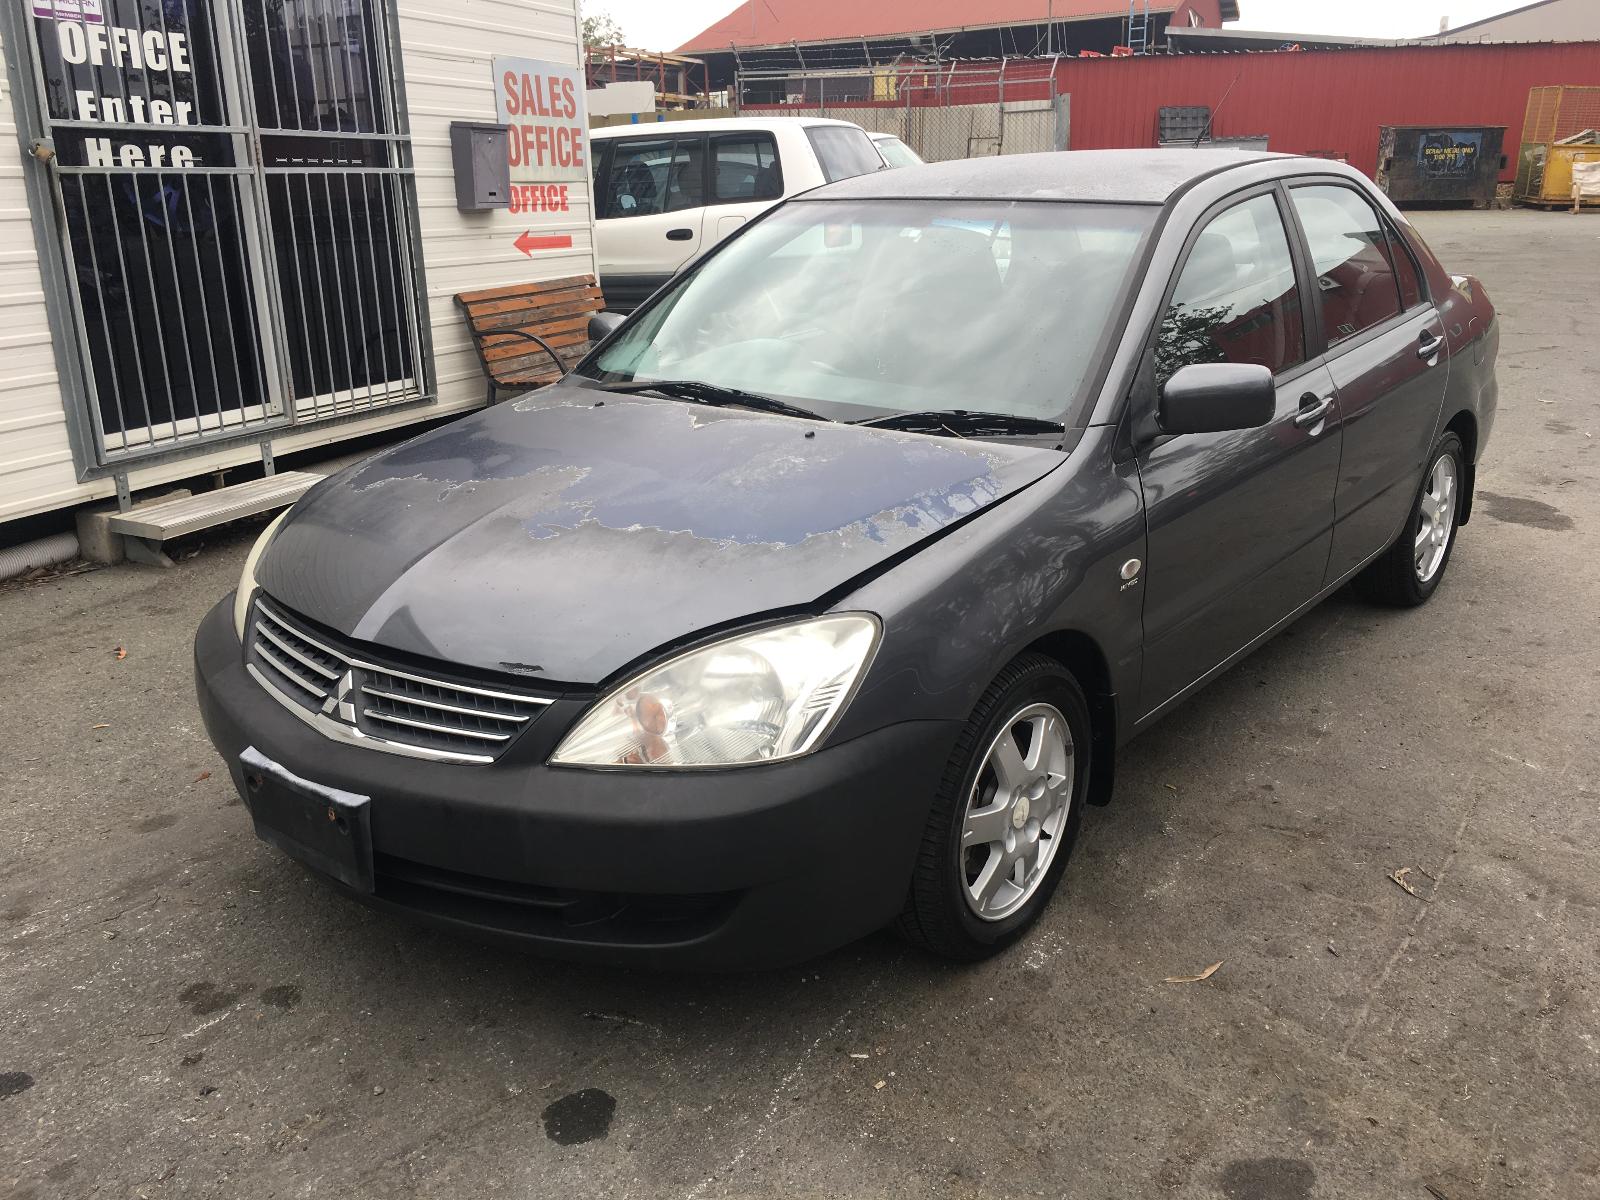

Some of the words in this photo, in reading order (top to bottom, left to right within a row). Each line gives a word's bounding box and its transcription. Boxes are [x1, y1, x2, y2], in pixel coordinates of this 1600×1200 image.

[57, 21, 191, 72] OFFICE
[75, 90, 192, 126] Enter
[503, 71, 577, 119] SALES
[84, 137, 195, 168] Here
[508, 124, 584, 168] OFFICE
[508, 184, 570, 214] OFFICE
